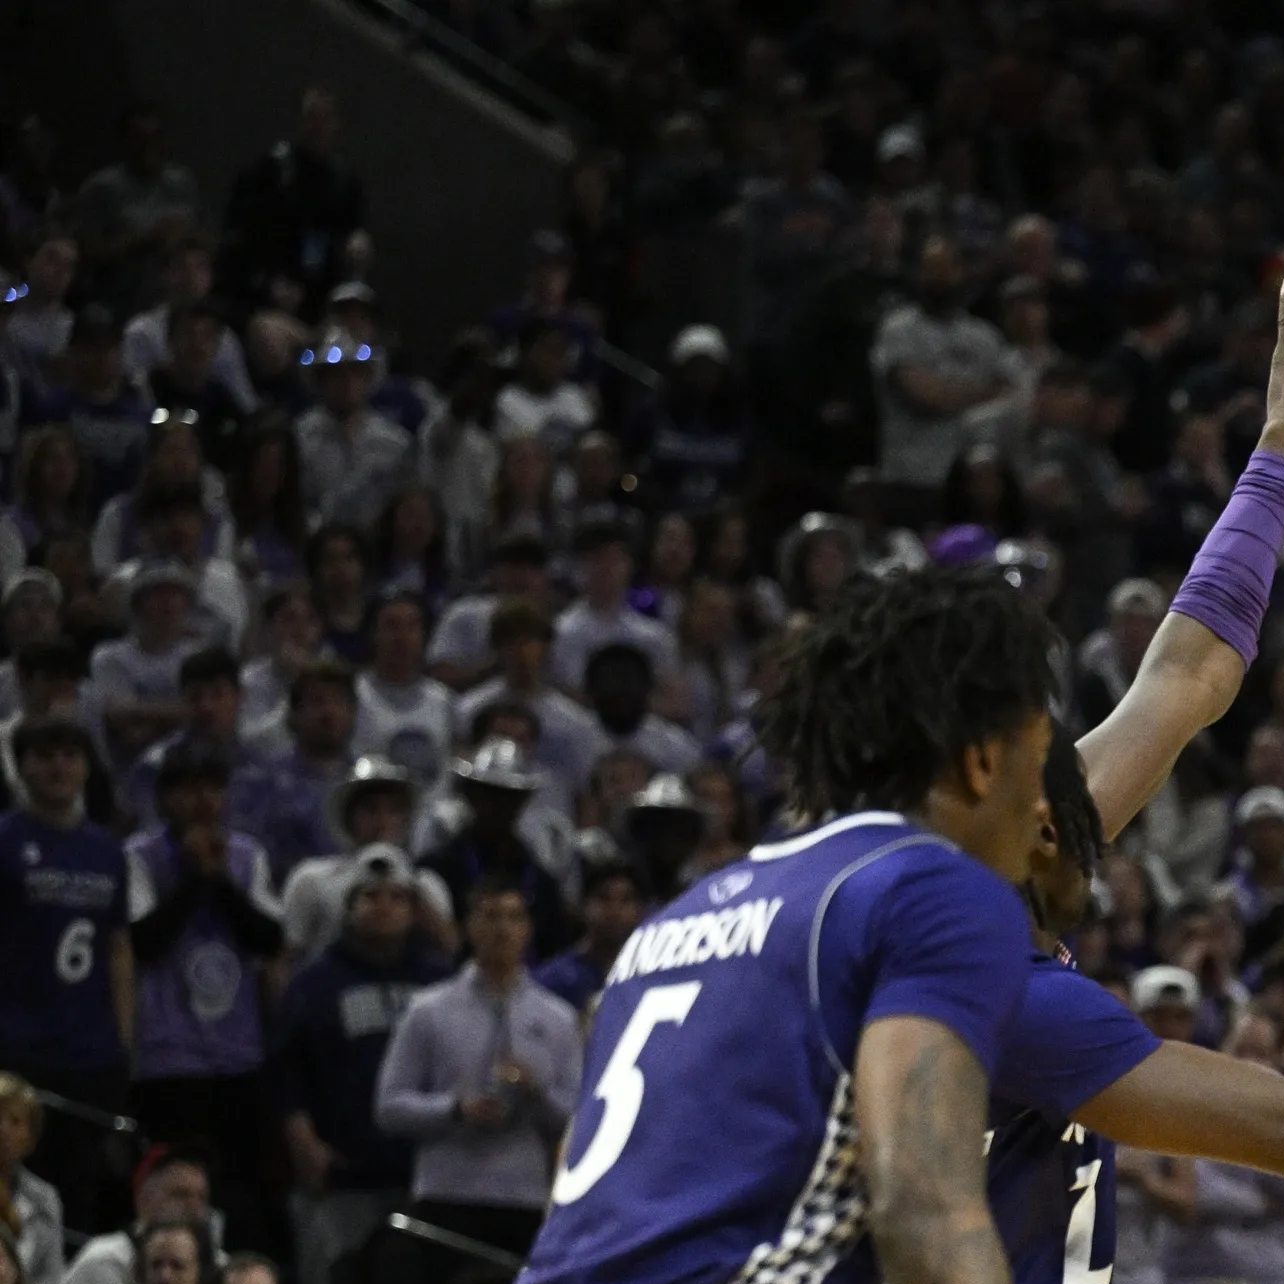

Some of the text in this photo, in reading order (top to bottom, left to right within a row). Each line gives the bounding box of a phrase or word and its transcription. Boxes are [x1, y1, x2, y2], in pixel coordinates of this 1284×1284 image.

[56, 917, 96, 983] 6
[605, 896, 784, 987] ANDERSON
[552, 979, 702, 1205] 5
